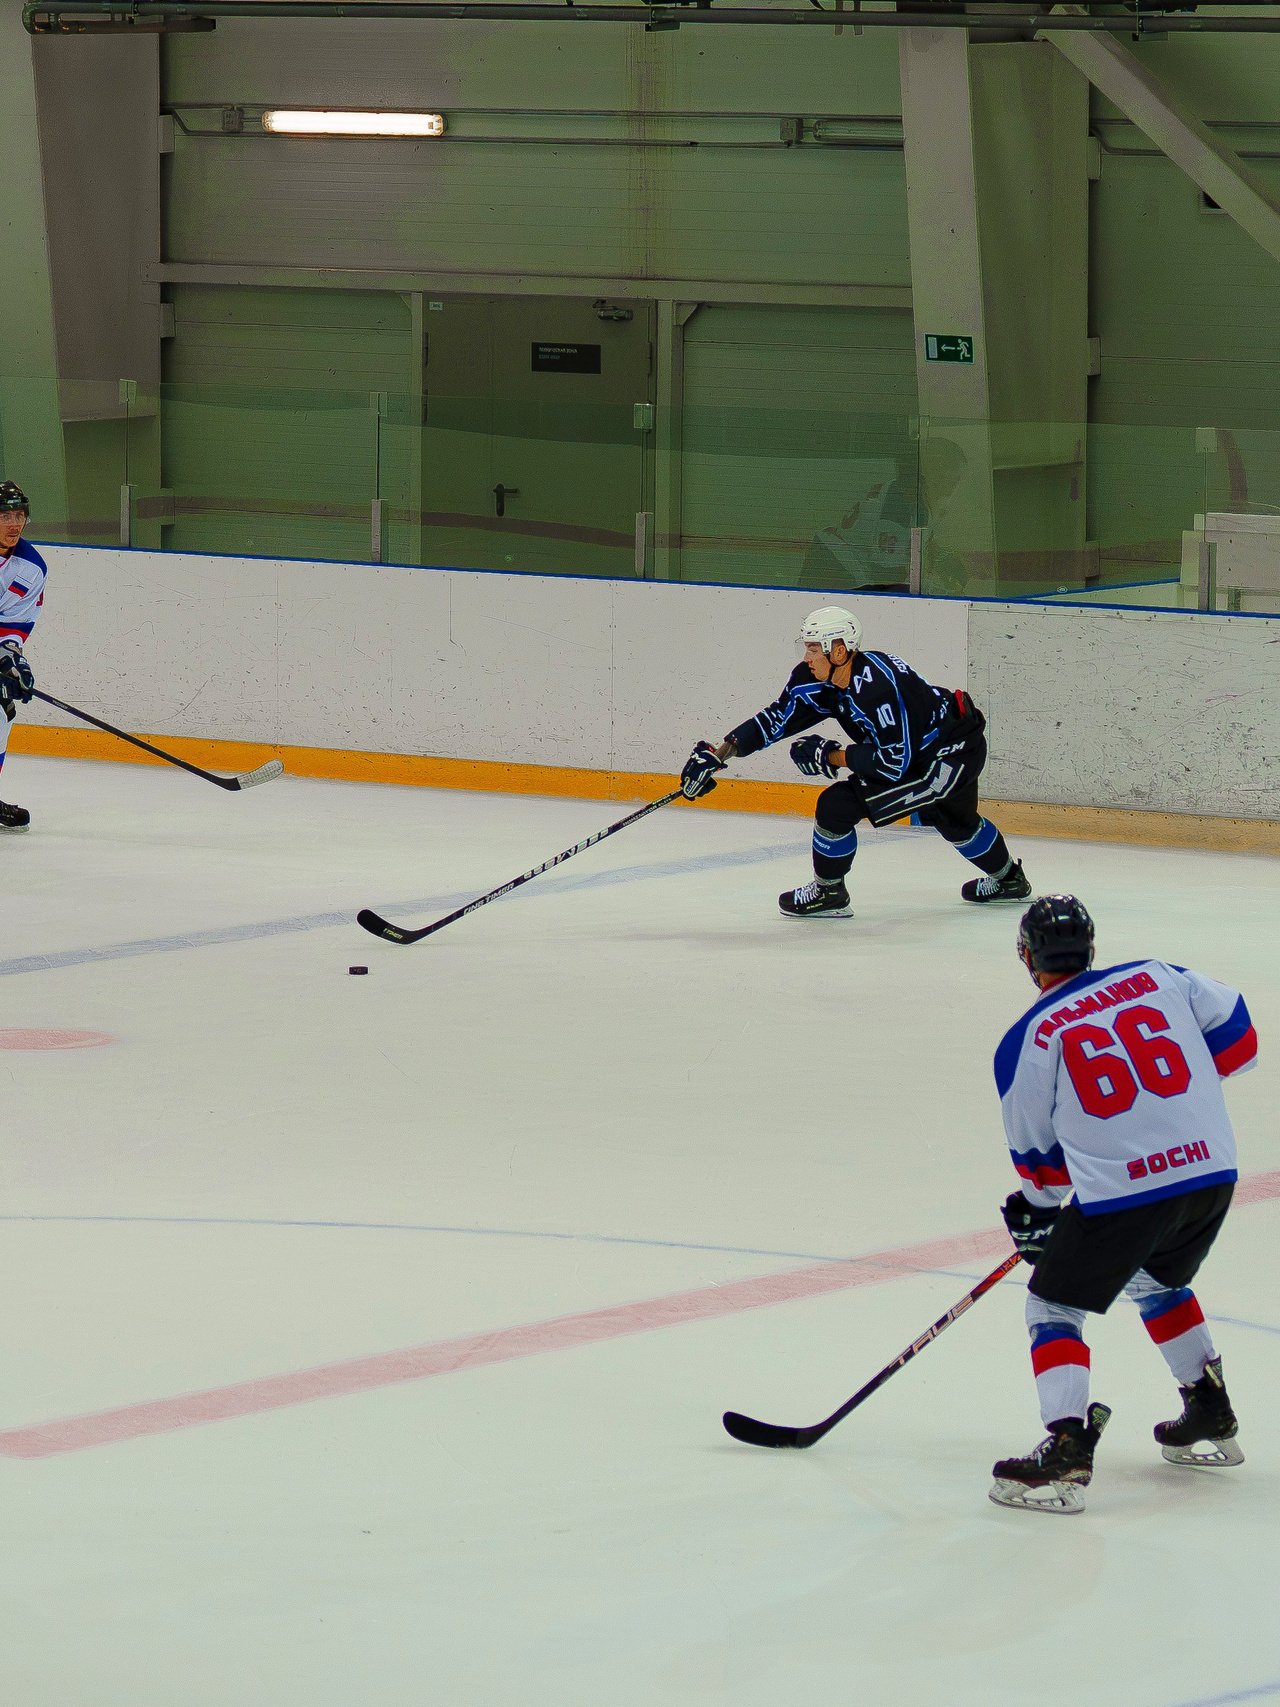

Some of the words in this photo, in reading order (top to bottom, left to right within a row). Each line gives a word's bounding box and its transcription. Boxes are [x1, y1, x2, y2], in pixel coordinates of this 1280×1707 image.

[876, 703, 896, 729] 10
[1060, 1004, 1193, 1121] 66
[1126, 1140, 1211, 1181] SOCHI
